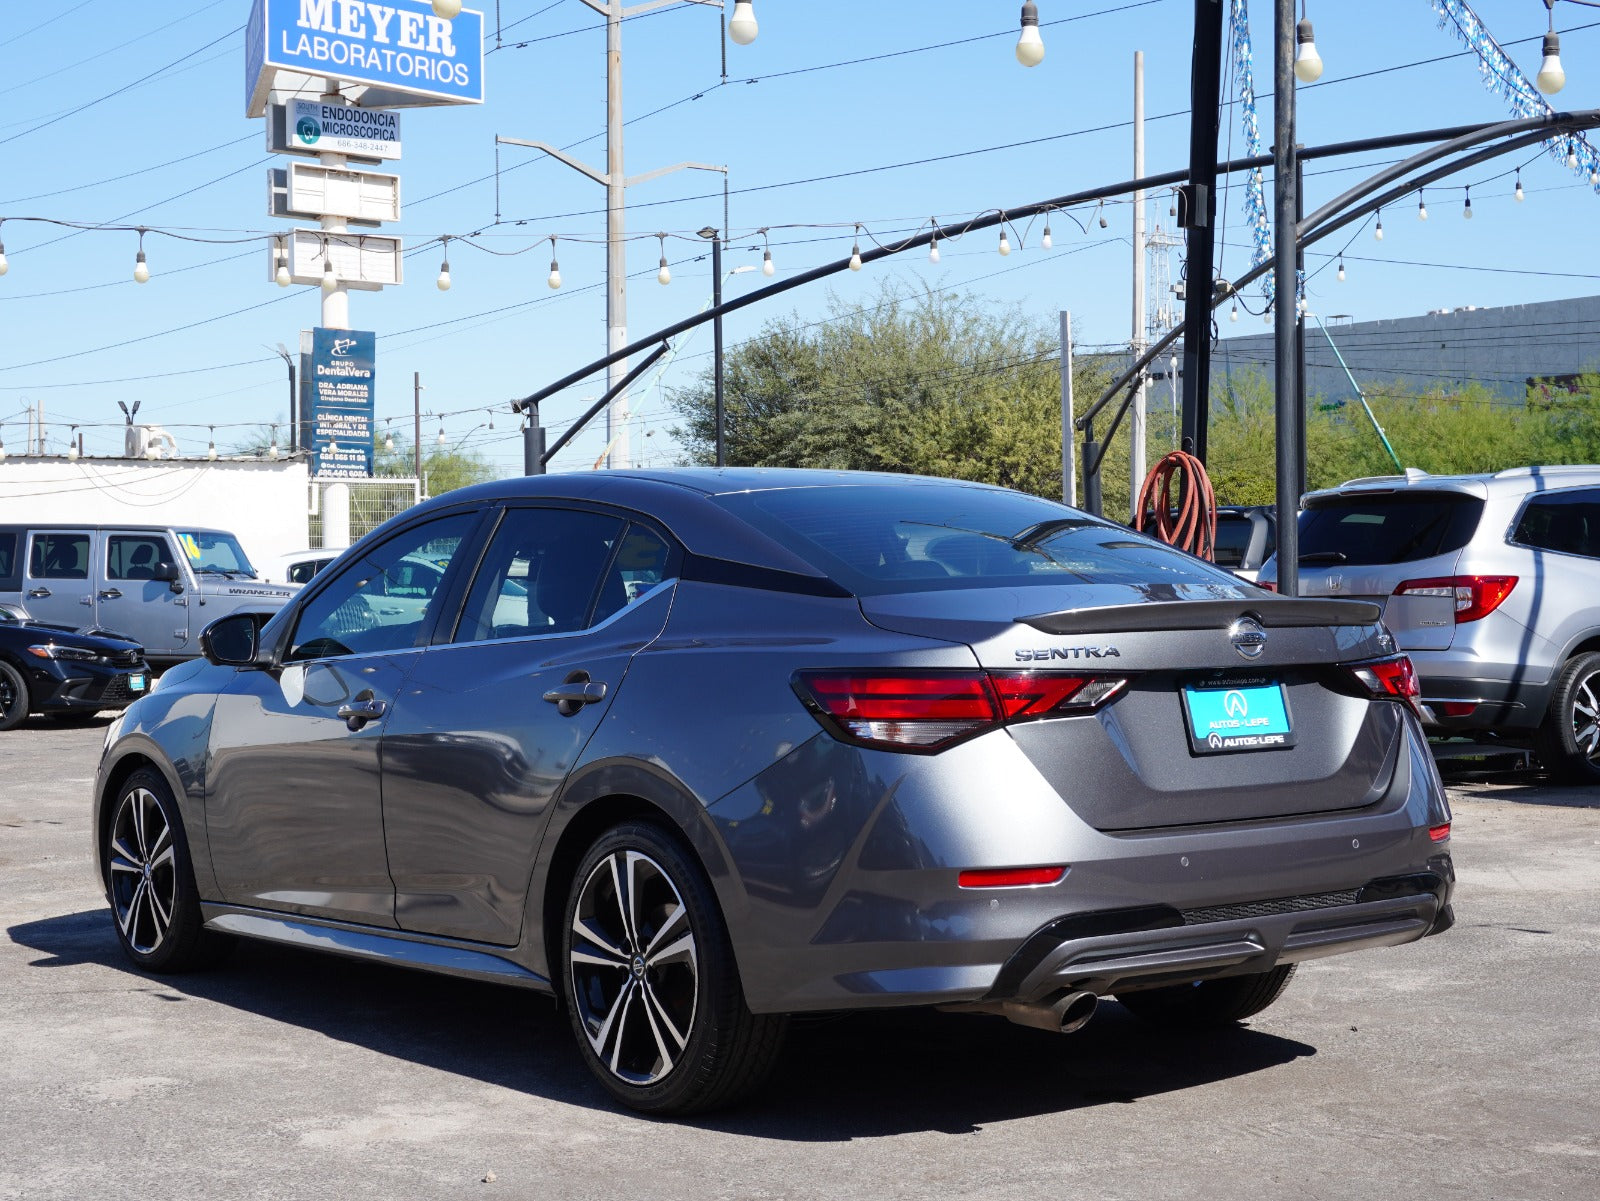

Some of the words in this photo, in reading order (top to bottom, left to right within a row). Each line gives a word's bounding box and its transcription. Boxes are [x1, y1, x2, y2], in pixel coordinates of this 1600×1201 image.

[297, 0, 456, 57] MEYER
[282, 30, 469, 86] LABORATORIOS
[322, 106, 396, 128] ENDODONCIA
[322, 121, 396, 142] MICROSCOPICA
[317, 364, 371, 378] DentalVera
[336, 383, 369, 391] ADRIANA
[337, 390, 369, 398] MORALES
[316, 428, 370, 437] ESPECIALIDADES
[319, 422, 352, 430] INTGRAL
[229, 588, 291, 597] WRANGLER
[1015, 645, 1120, 661] SENTRA
